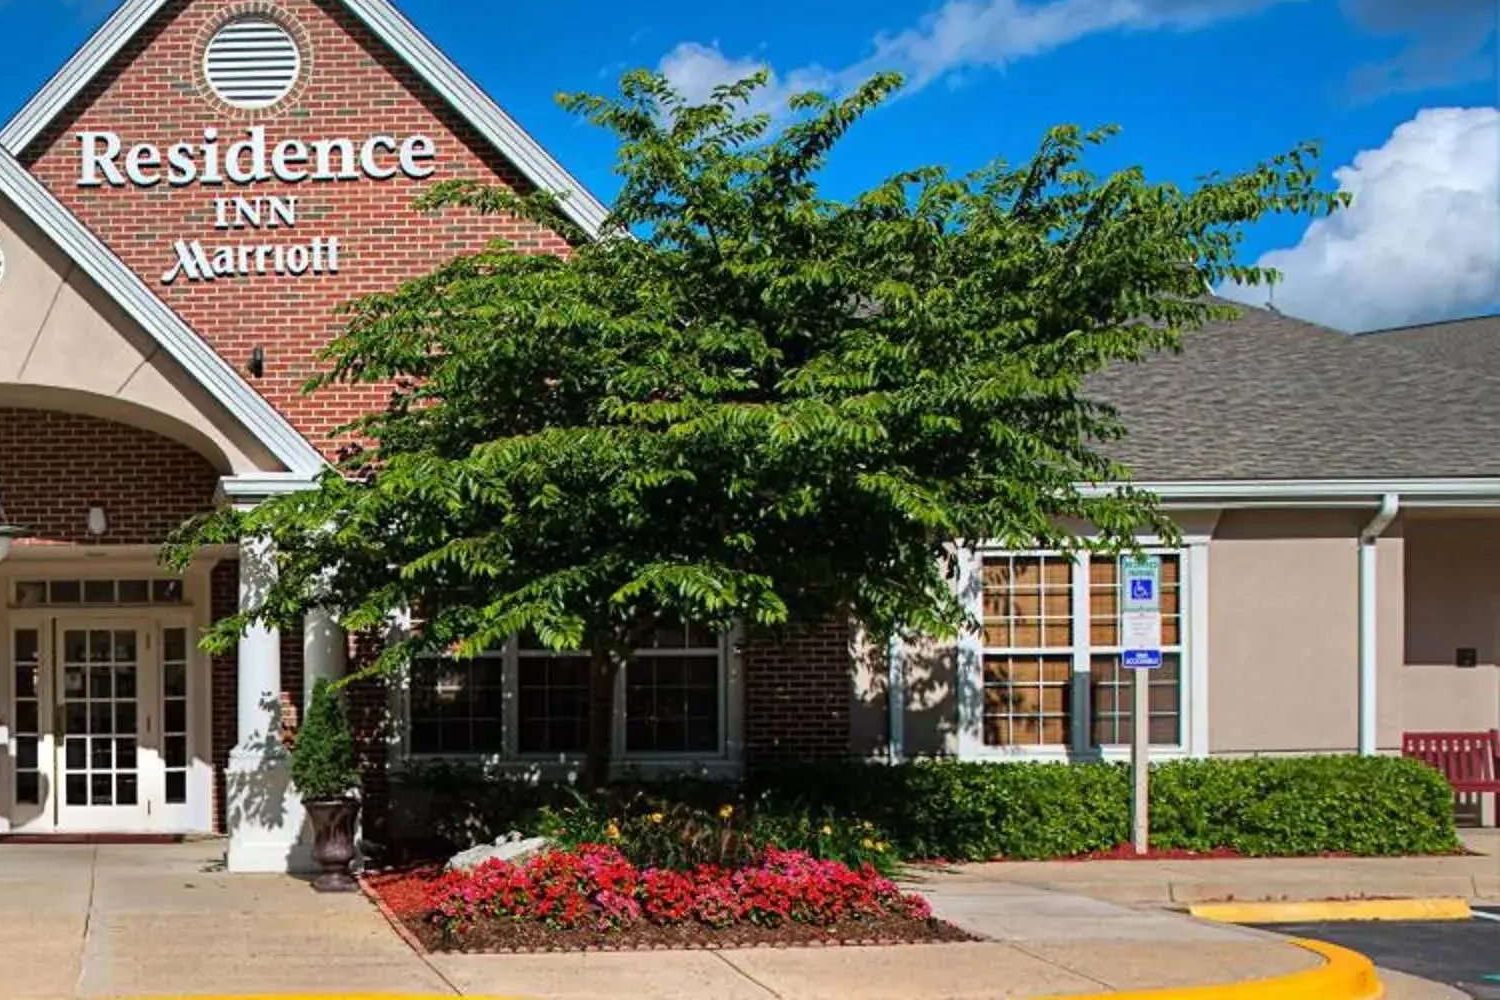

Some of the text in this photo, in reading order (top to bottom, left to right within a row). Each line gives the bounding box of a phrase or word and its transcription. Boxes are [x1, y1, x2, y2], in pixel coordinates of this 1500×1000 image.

[75, 125, 436, 186] Residence
[213, 197, 298, 228] INN
[160, 236, 341, 283] Marriott
